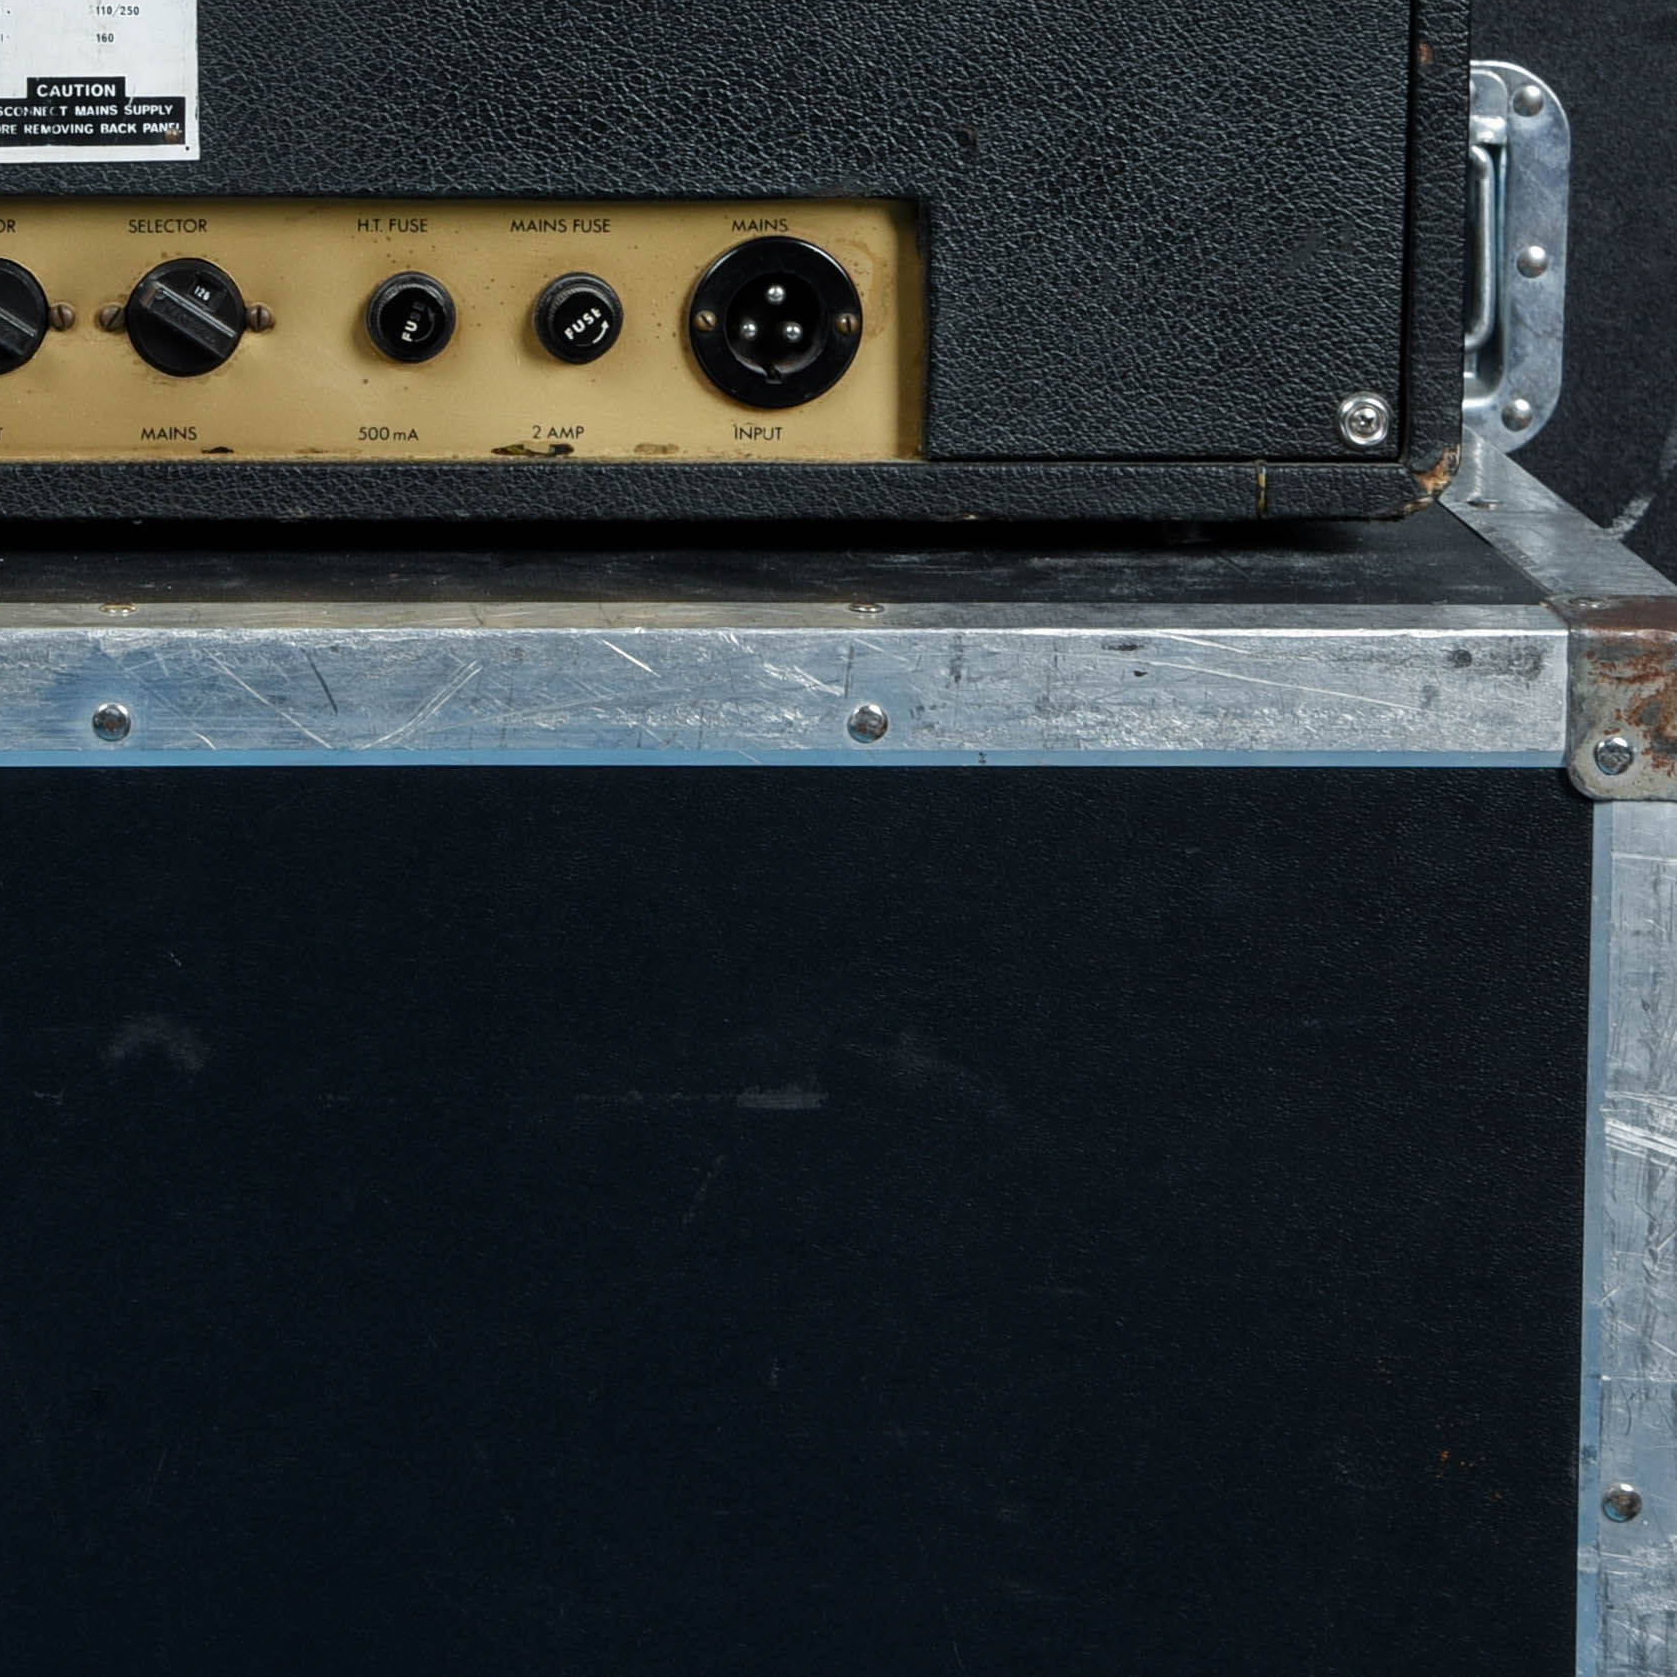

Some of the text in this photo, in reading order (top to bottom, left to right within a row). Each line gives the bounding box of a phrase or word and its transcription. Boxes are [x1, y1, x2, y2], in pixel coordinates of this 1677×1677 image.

[96, 5, 140, 17] 110/250
[96, 33, 114, 43] 160
[36, 84, 116, 97] CAUTION
[75, 105, 118, 116] MAINS
[124, 105, 173, 116] SUPPLY
[24, 124, 94, 135] REMOVING
[100, 123, 137, 134] BACK
[128, 218, 208, 234] SELECTOR
[357, 218, 428, 234] H.T. FUSE
[510, 218, 611, 234] MAINS FUSE
[731, 218, 789, 233] MAINS
[140, 427, 198, 442] MAINS
[532, 425, 585, 439] 2 AMP
[733, 427, 783, 442] INPUT
